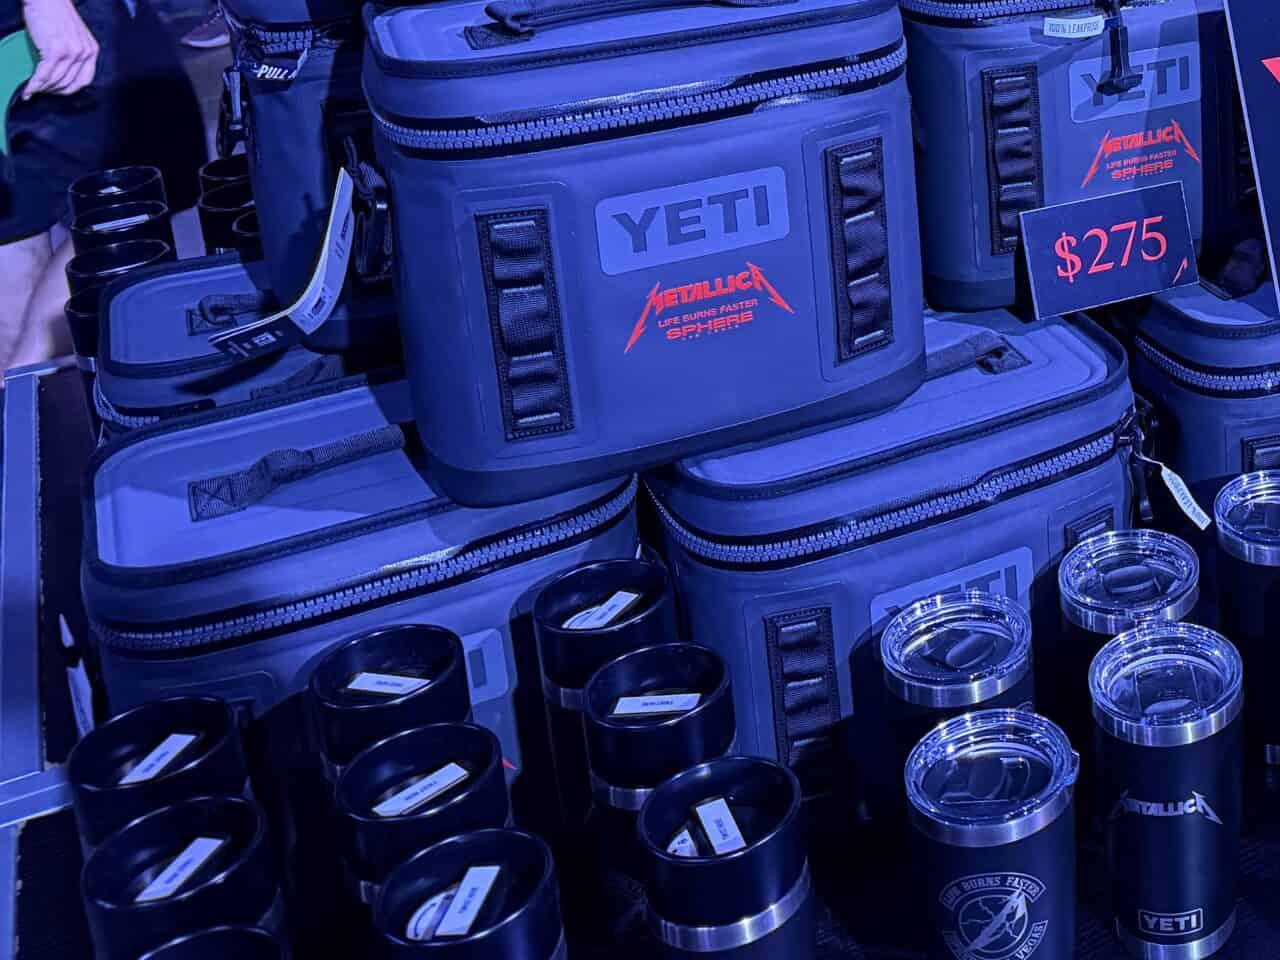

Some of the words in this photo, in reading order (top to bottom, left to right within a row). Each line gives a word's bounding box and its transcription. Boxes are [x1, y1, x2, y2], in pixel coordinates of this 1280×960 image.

[257, 64, 288, 79] PULL
[1080, 119, 1201, 189] METALLICA
[1111, 160, 1174, 180] SPHERE
[611, 184, 771, 255] YETI
[1054, 215, 1168, 283] $275
[624, 261, 794, 354] METALLICA
[657, 316, 681, 328] LIFE
[682, 308, 717, 322] BURNS
[719, 298, 759, 314] FASTER
[666, 310, 753, 340] SPHERE
[1107, 790, 1223, 824] METALLICA
[961, 876, 1001, 891] BURNS
[1144, 914, 1197, 931] YETI
[1016, 924, 1044, 959] VEGAS
